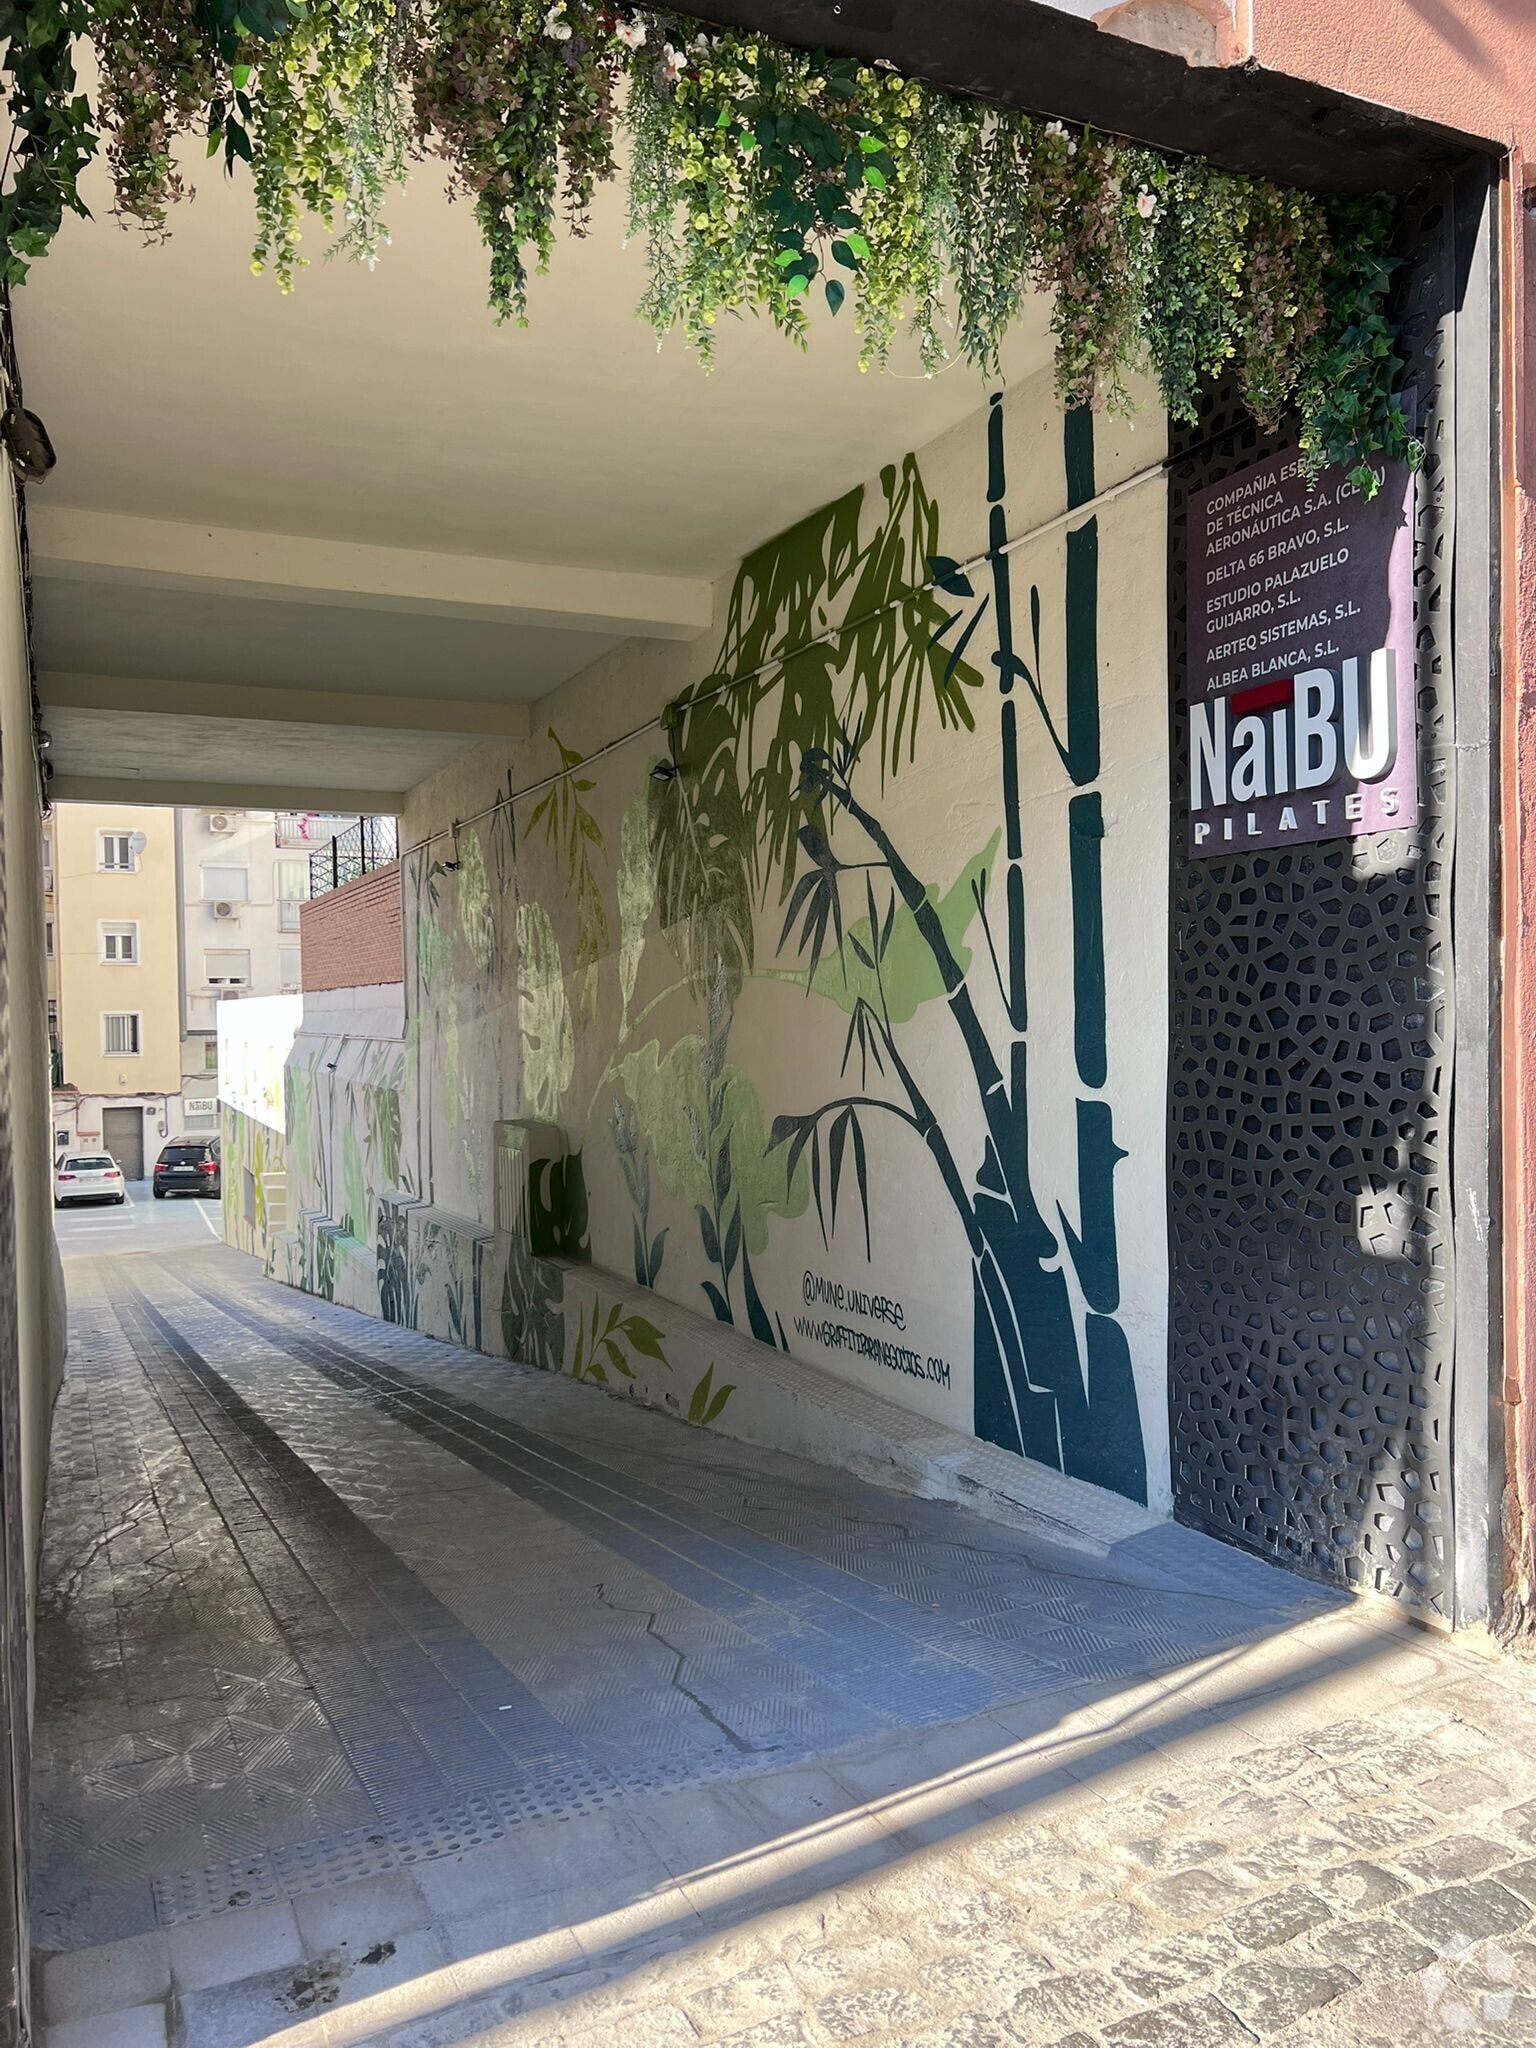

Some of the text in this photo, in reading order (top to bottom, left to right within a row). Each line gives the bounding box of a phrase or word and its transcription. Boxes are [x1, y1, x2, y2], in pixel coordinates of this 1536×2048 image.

[1206, 472, 1277, 515] COMPAÑIA
[1206, 491, 1284, 536] DE TÉCNICA
[1205, 505, 1300, 557] AERONÁUTICA
[1304, 494, 1332, 515] S.A.
[1206, 519, 1350, 585] DELTA 66 BRAVO, S.L.
[1206, 547, 1349, 614] ESTUDIO PALAZUELO
[1206, 590, 1301, 634] GUIJARRO, S.L.
[1206, 600, 1361, 663] AERTEQ SISTEMAS, S.L.
[1206, 640, 1340, 692] ALBEA BLANCA, S.L.
[1194, 787, 1400, 845] PILATES
